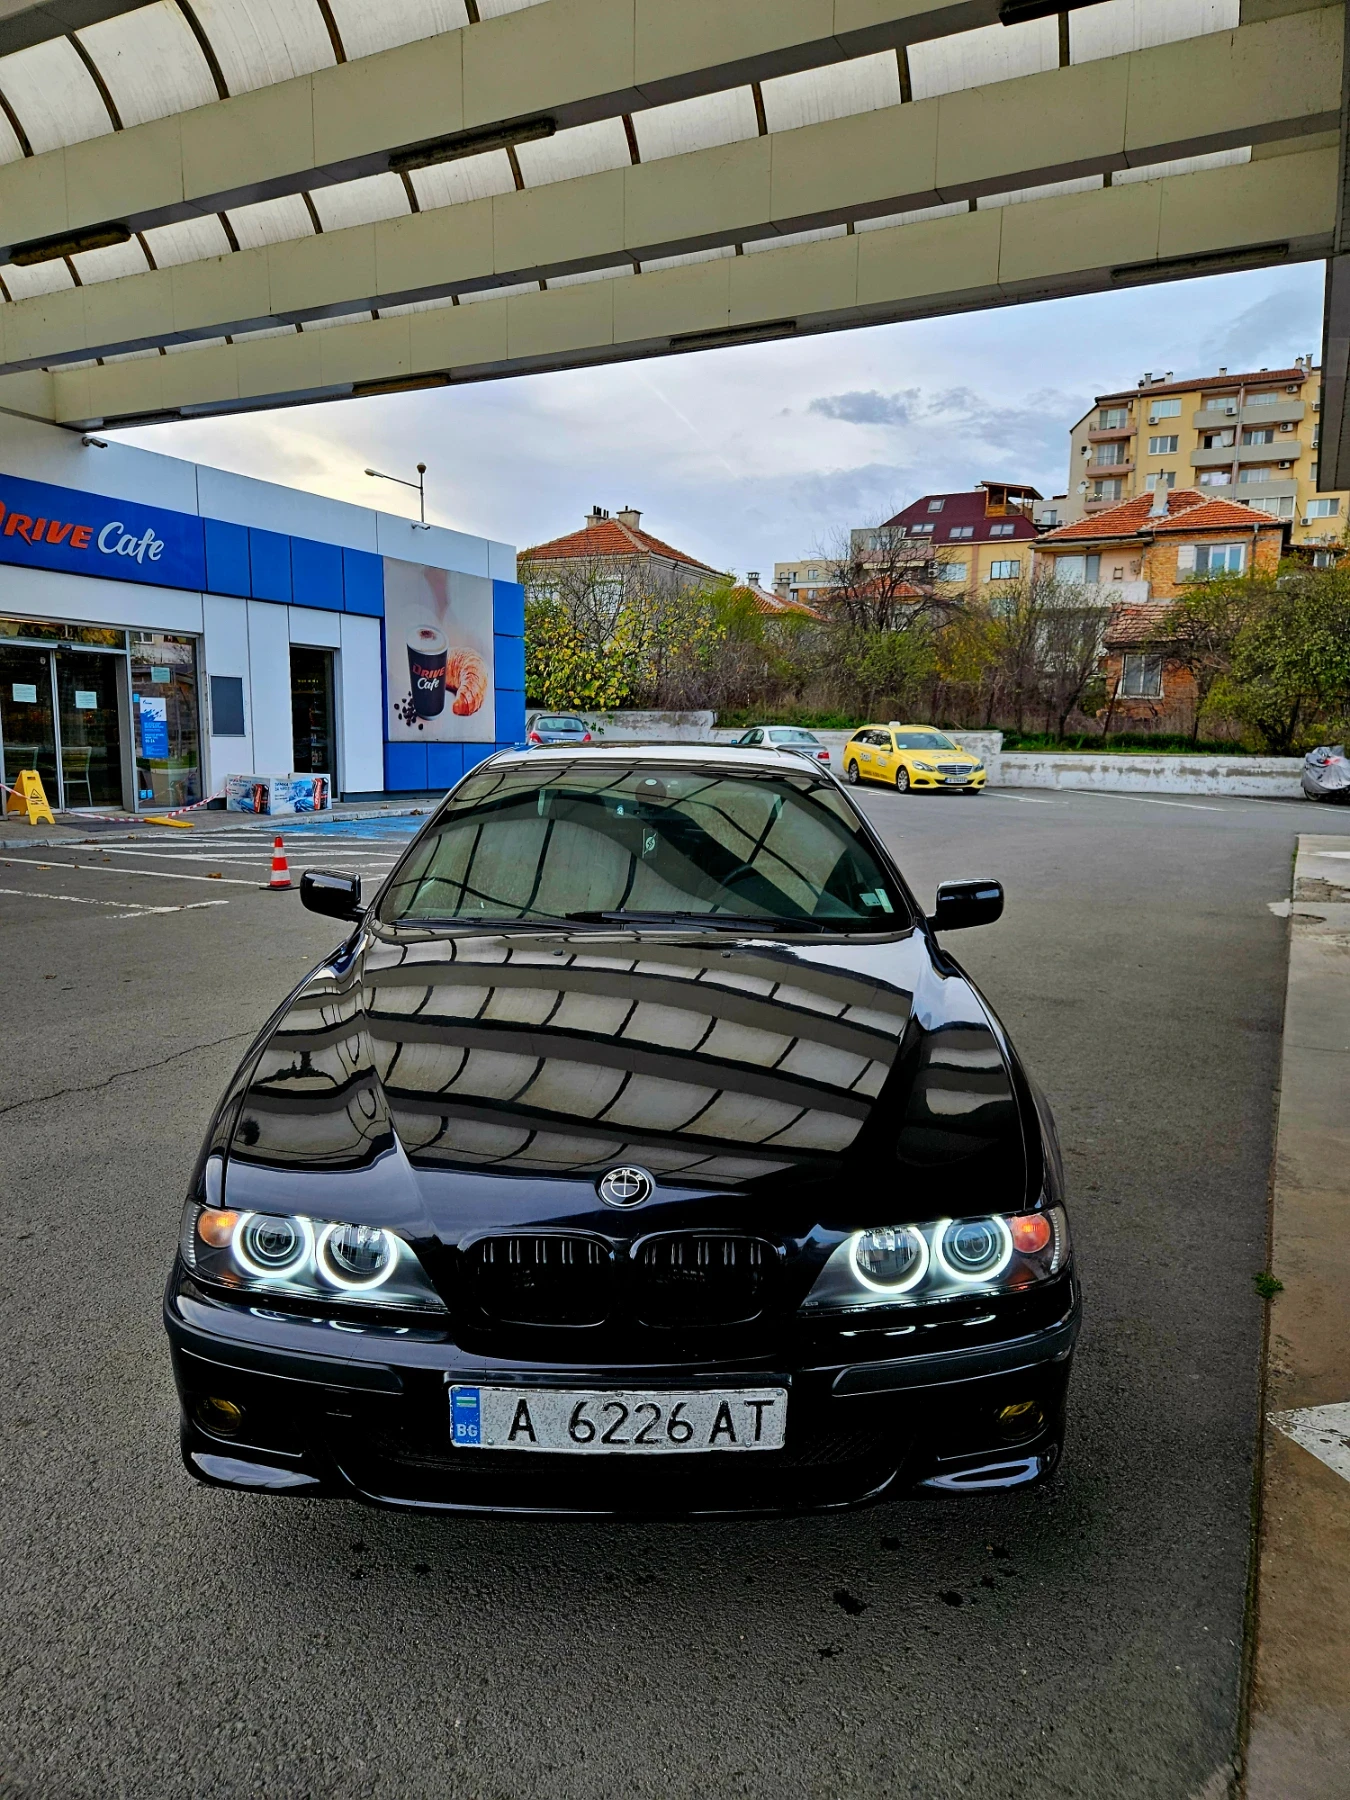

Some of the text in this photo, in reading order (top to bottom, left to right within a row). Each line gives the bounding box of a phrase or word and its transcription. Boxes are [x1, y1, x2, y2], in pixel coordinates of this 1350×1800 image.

[413, 663, 445, 680] DRIVE
[608, 1169, 644, 1181] BMW
[507, 1397, 775, 1445] A 6226 AT
[457, 1424, 478, 1437] BG
